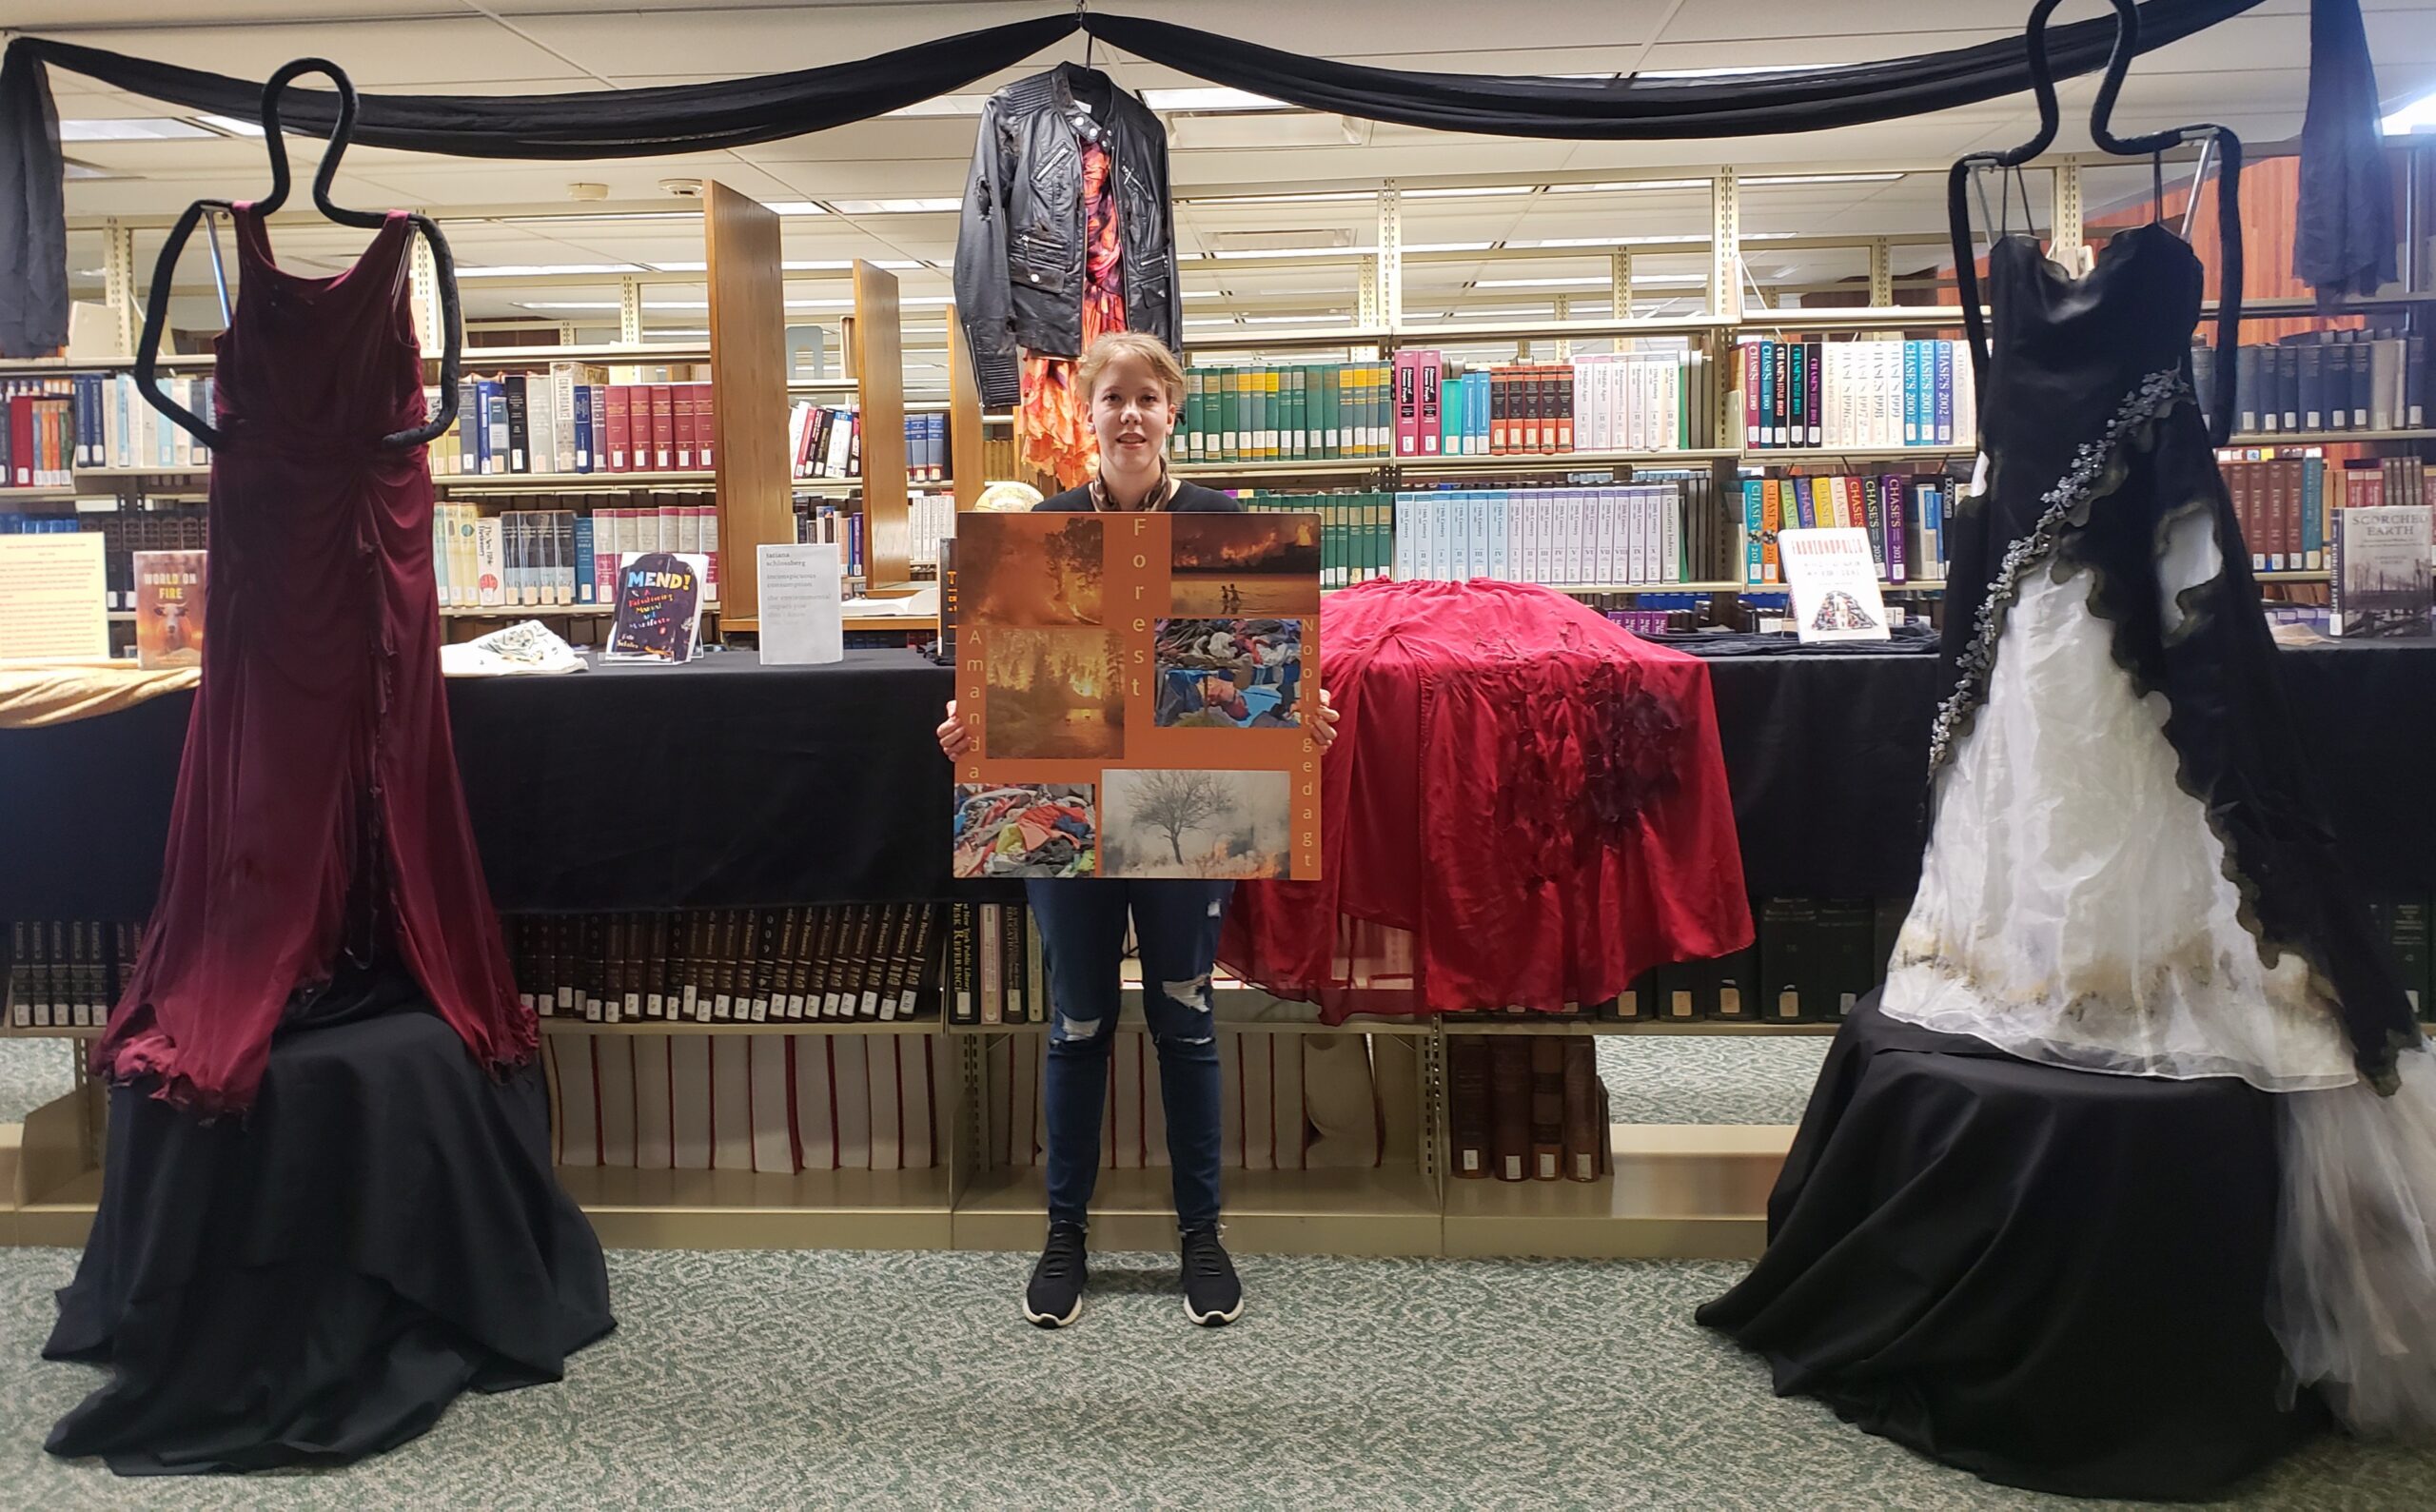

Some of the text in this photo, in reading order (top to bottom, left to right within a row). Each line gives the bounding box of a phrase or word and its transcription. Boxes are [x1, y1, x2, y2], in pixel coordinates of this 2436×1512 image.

[1906, 343, 1915, 415] CHASE'S 2000
[1921, 343, 1932, 413] CHASE'S 2001
[1938, 343, 1950, 415] CHASE'S 2002
[1752, 485, 1761, 527] CHASE'S
[1767, 485, 1777, 527] CHASE'S
[1866, 481, 1881, 562] CHASE'S 2020
[1889, 479, 1901, 562] CHASE'S 2021
[2352, 514, 2427, 525] SCORCHED
[2367, 525, 2413, 536] EARTH
[144, 574, 197, 584] WORLD ON
[159, 588, 183, 599] FIRE
[628, 571, 691, 591] MEND!
[1131, 518, 1148, 697] Forest
[967, 630, 984, 779] Amanda
[1301, 619, 1314, 867] Nooitgedagt
